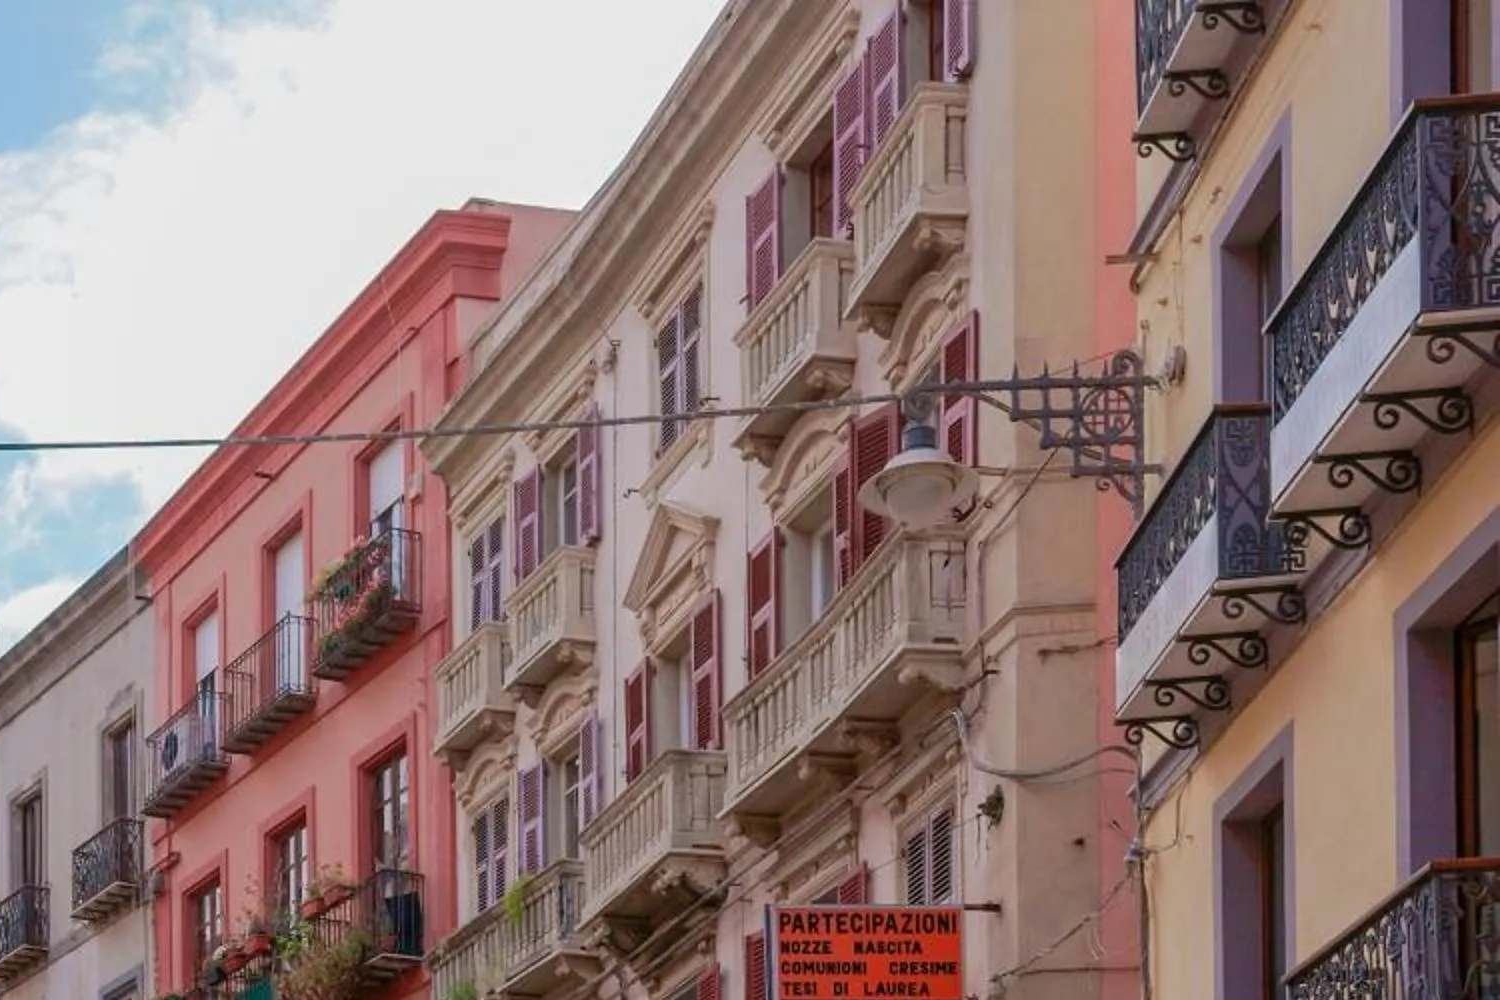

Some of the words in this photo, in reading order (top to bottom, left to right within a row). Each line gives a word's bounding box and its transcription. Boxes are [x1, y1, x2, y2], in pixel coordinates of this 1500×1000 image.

[779, 912, 957, 935] PARTECIPAZIONI
[781, 941, 832, 955] NOZZE
[854, 941, 923, 955] NASCITA
[781, 961, 867, 975] COMUNIONI
[889, 961, 957, 975] CRESIME
[783, 982, 818, 996] TESI
[833, 982, 848, 996] DI
[864, 982, 929, 996] LAUREA
